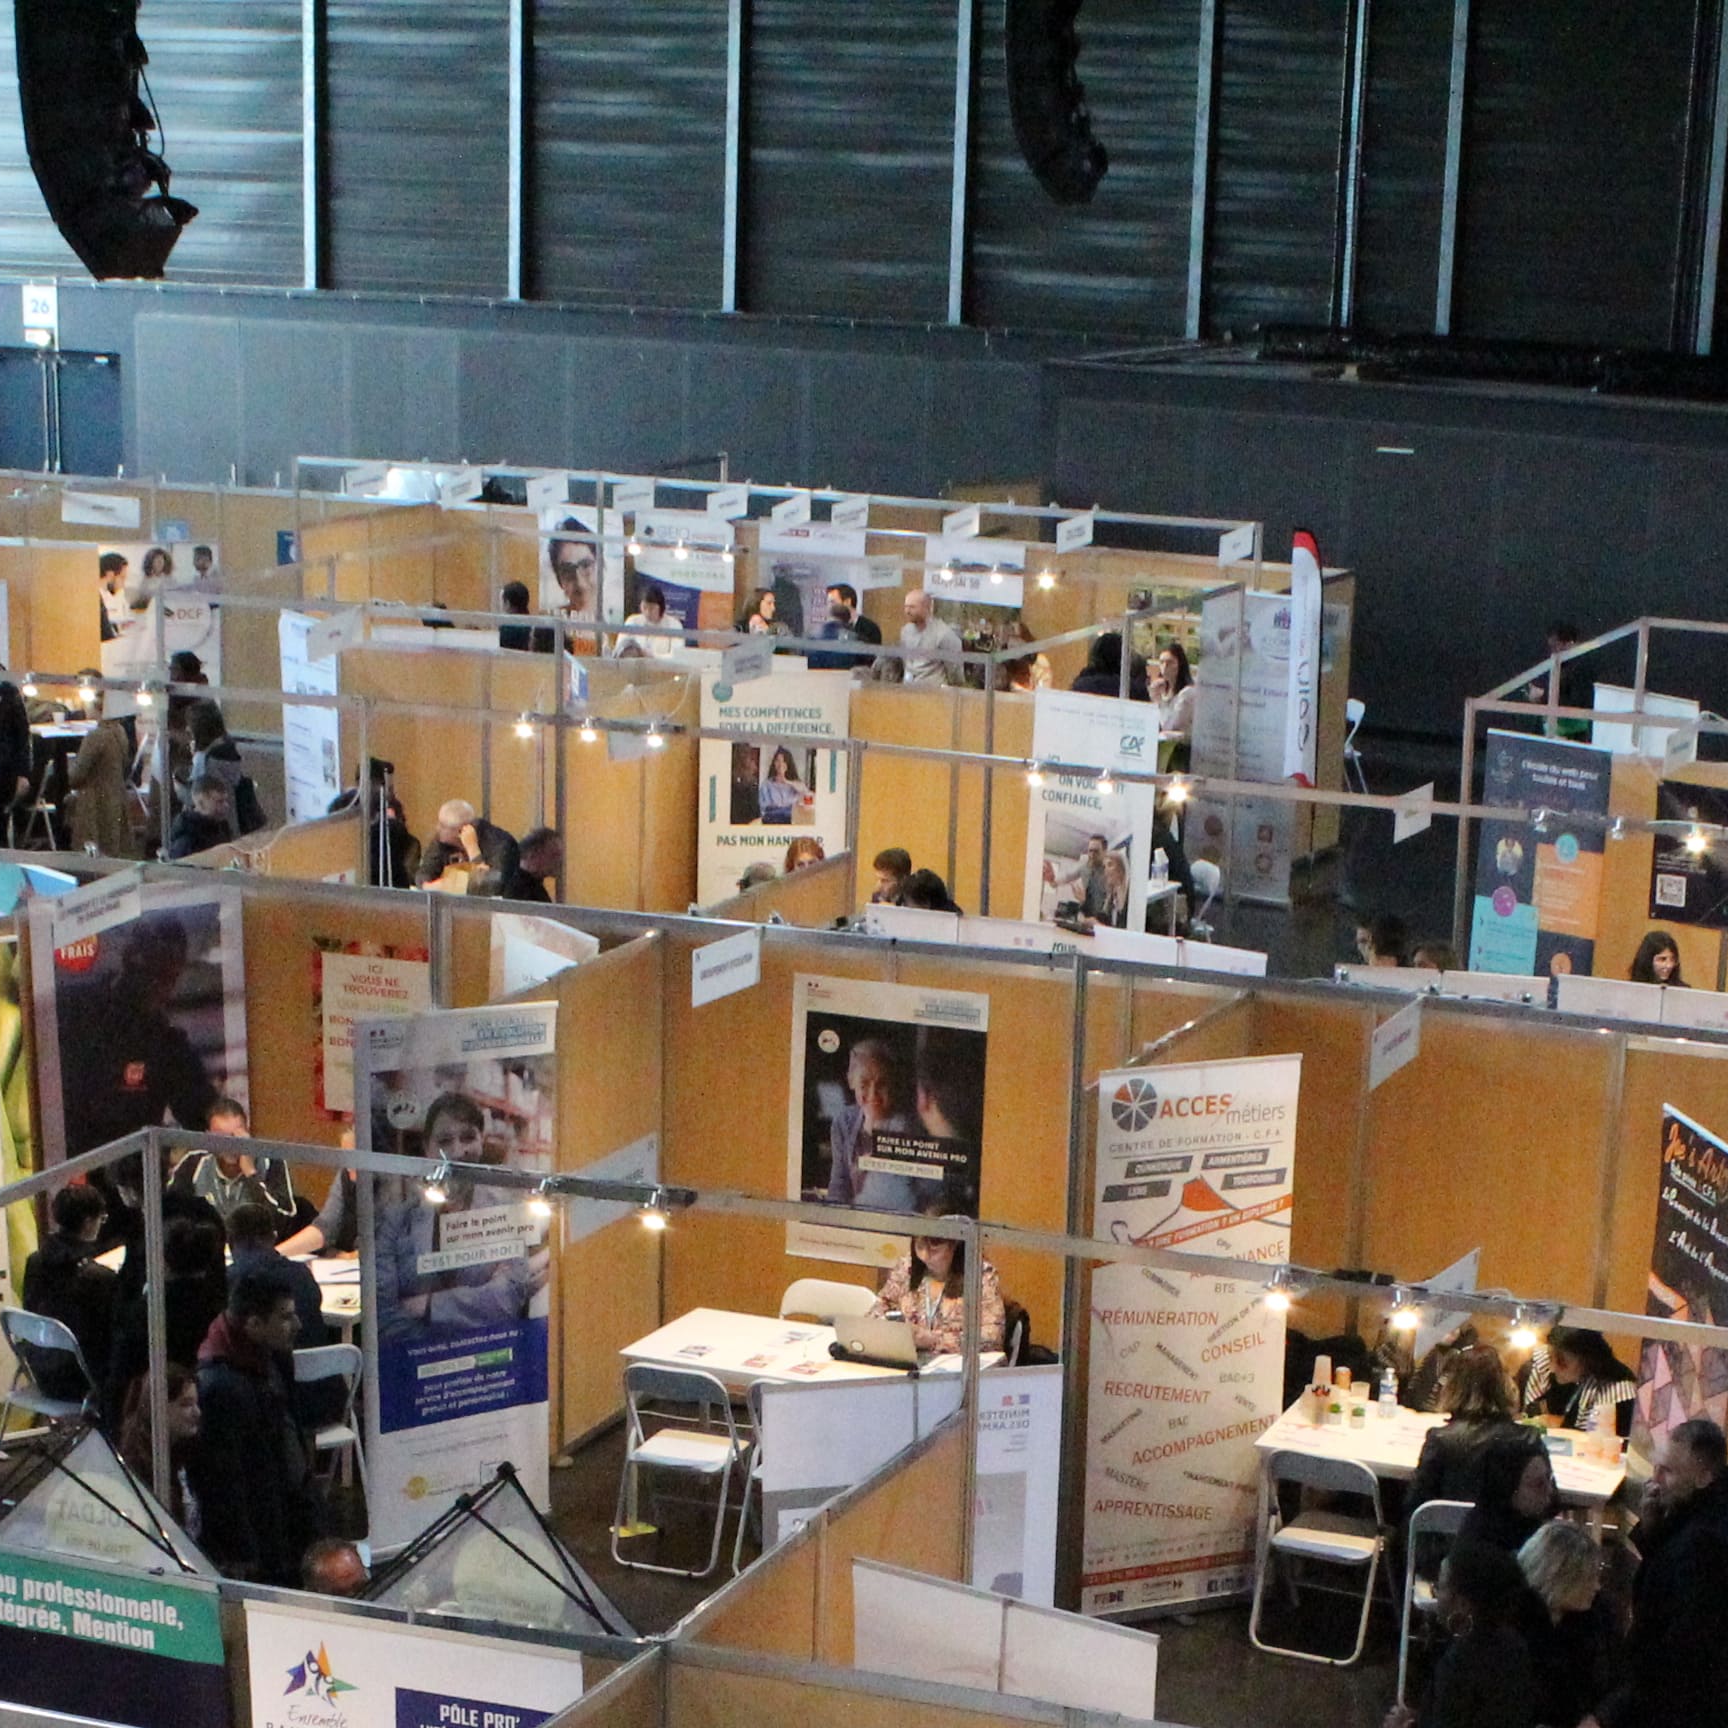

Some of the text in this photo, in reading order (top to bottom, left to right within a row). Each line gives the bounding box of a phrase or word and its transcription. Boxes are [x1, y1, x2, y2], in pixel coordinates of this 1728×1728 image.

[719, 705, 822, 719] MES COMPÉTENCES
[717, 835, 764, 847] PAS MON
[59, 942, 95, 961] FRAIS
[1159, 1092, 1286, 1125] ACCES métiers
[876, 1135, 940, 1150] FAIRE POINT
[1109, 1132, 1242, 1153] CENTRE FORMATION
[894, 1146, 968, 1164] MON AVENIR PRO
[445, 1213, 507, 1232] Faire point
[454, 1248, 489, 1265] POUR
[1214, 1282, 1236, 1294] BTS
[1102, 1309, 1220, 1326] RÉMUNÉRATION
[1200, 1331, 1265, 1365] CONSEIL
[1104, 1380, 1211, 1405] RECRUTEMENT
[1131, 1413, 1276, 1466] ACCOMPAGNEMENT
[1092, 1498, 1214, 1522] APPRENTISSAGE
[22, 1576, 184, 1631] professionnelle,
[73, 1608, 155, 1650] Mention
[439, 1702, 479, 1728] PÔLE
